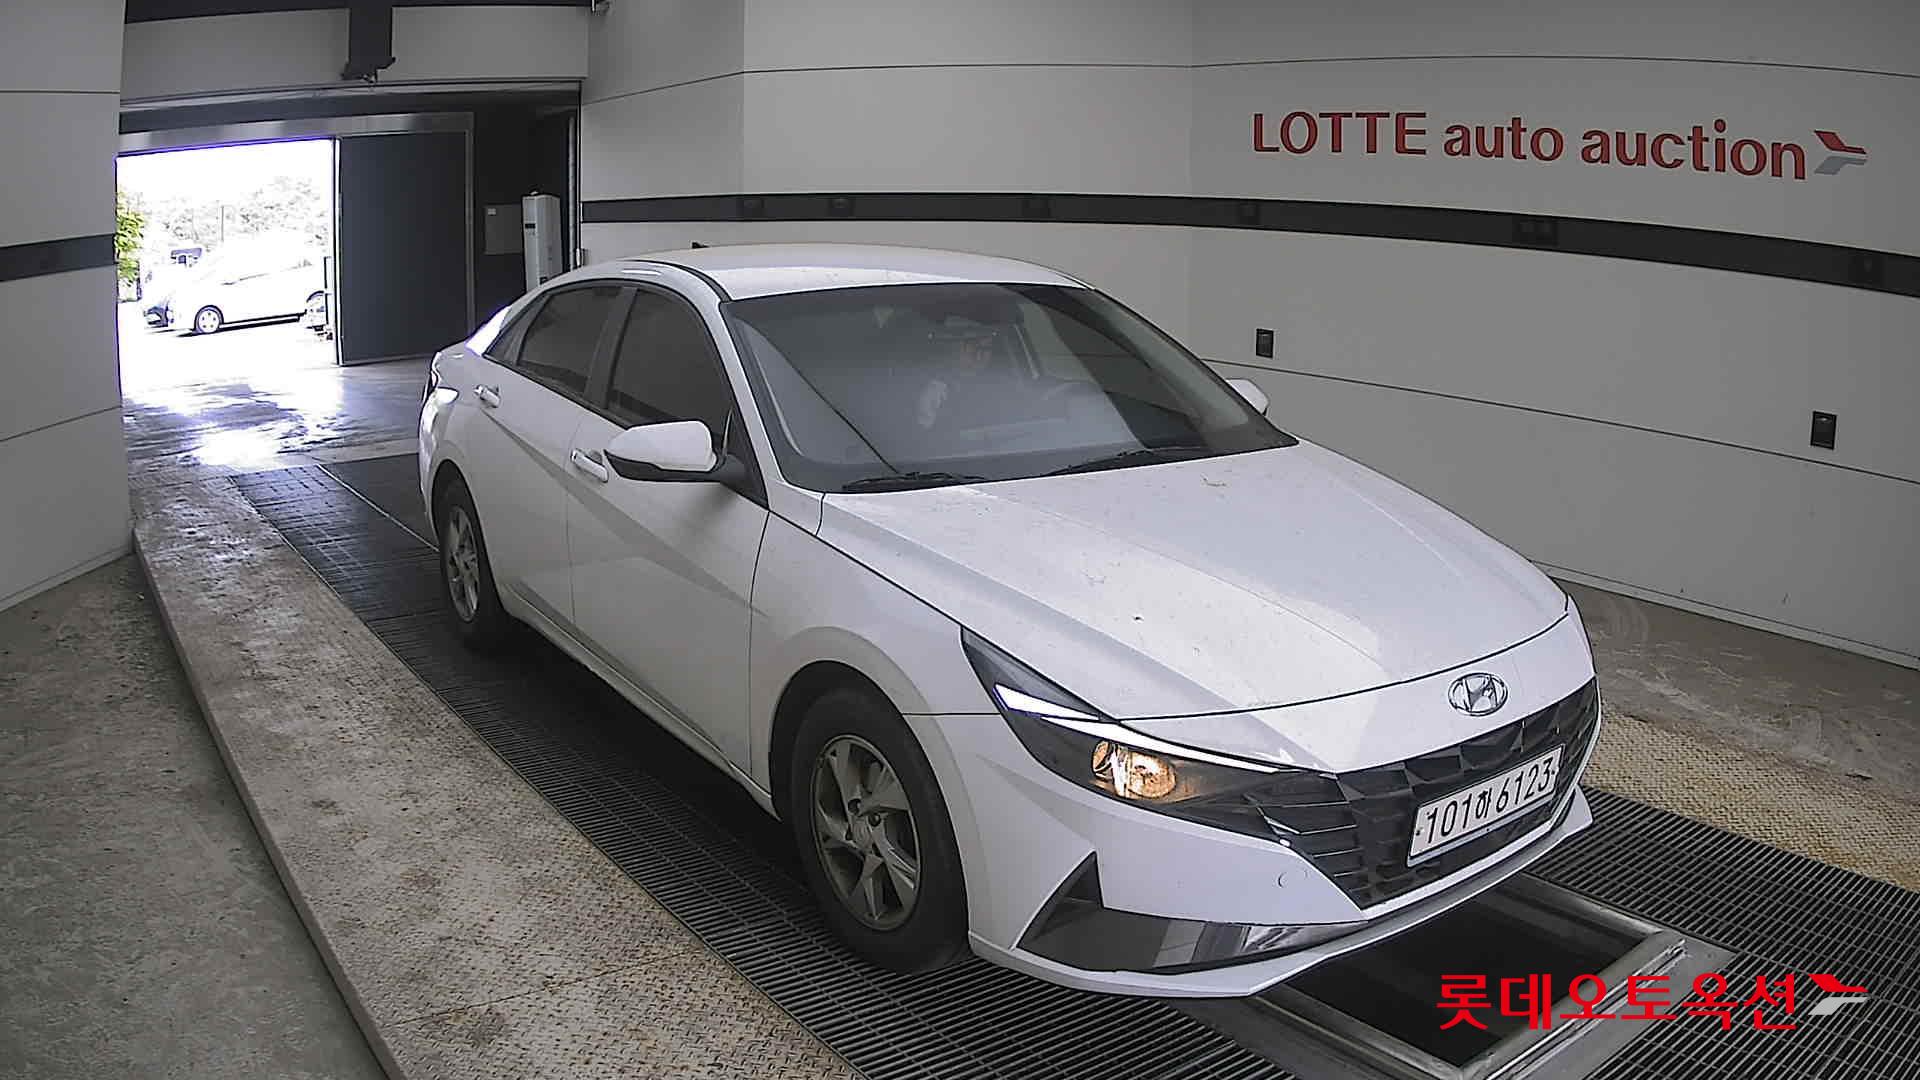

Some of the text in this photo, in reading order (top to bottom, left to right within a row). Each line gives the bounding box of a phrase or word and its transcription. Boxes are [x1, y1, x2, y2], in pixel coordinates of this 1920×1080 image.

[1252, 111, 1807, 180] LOTTE auto auction
